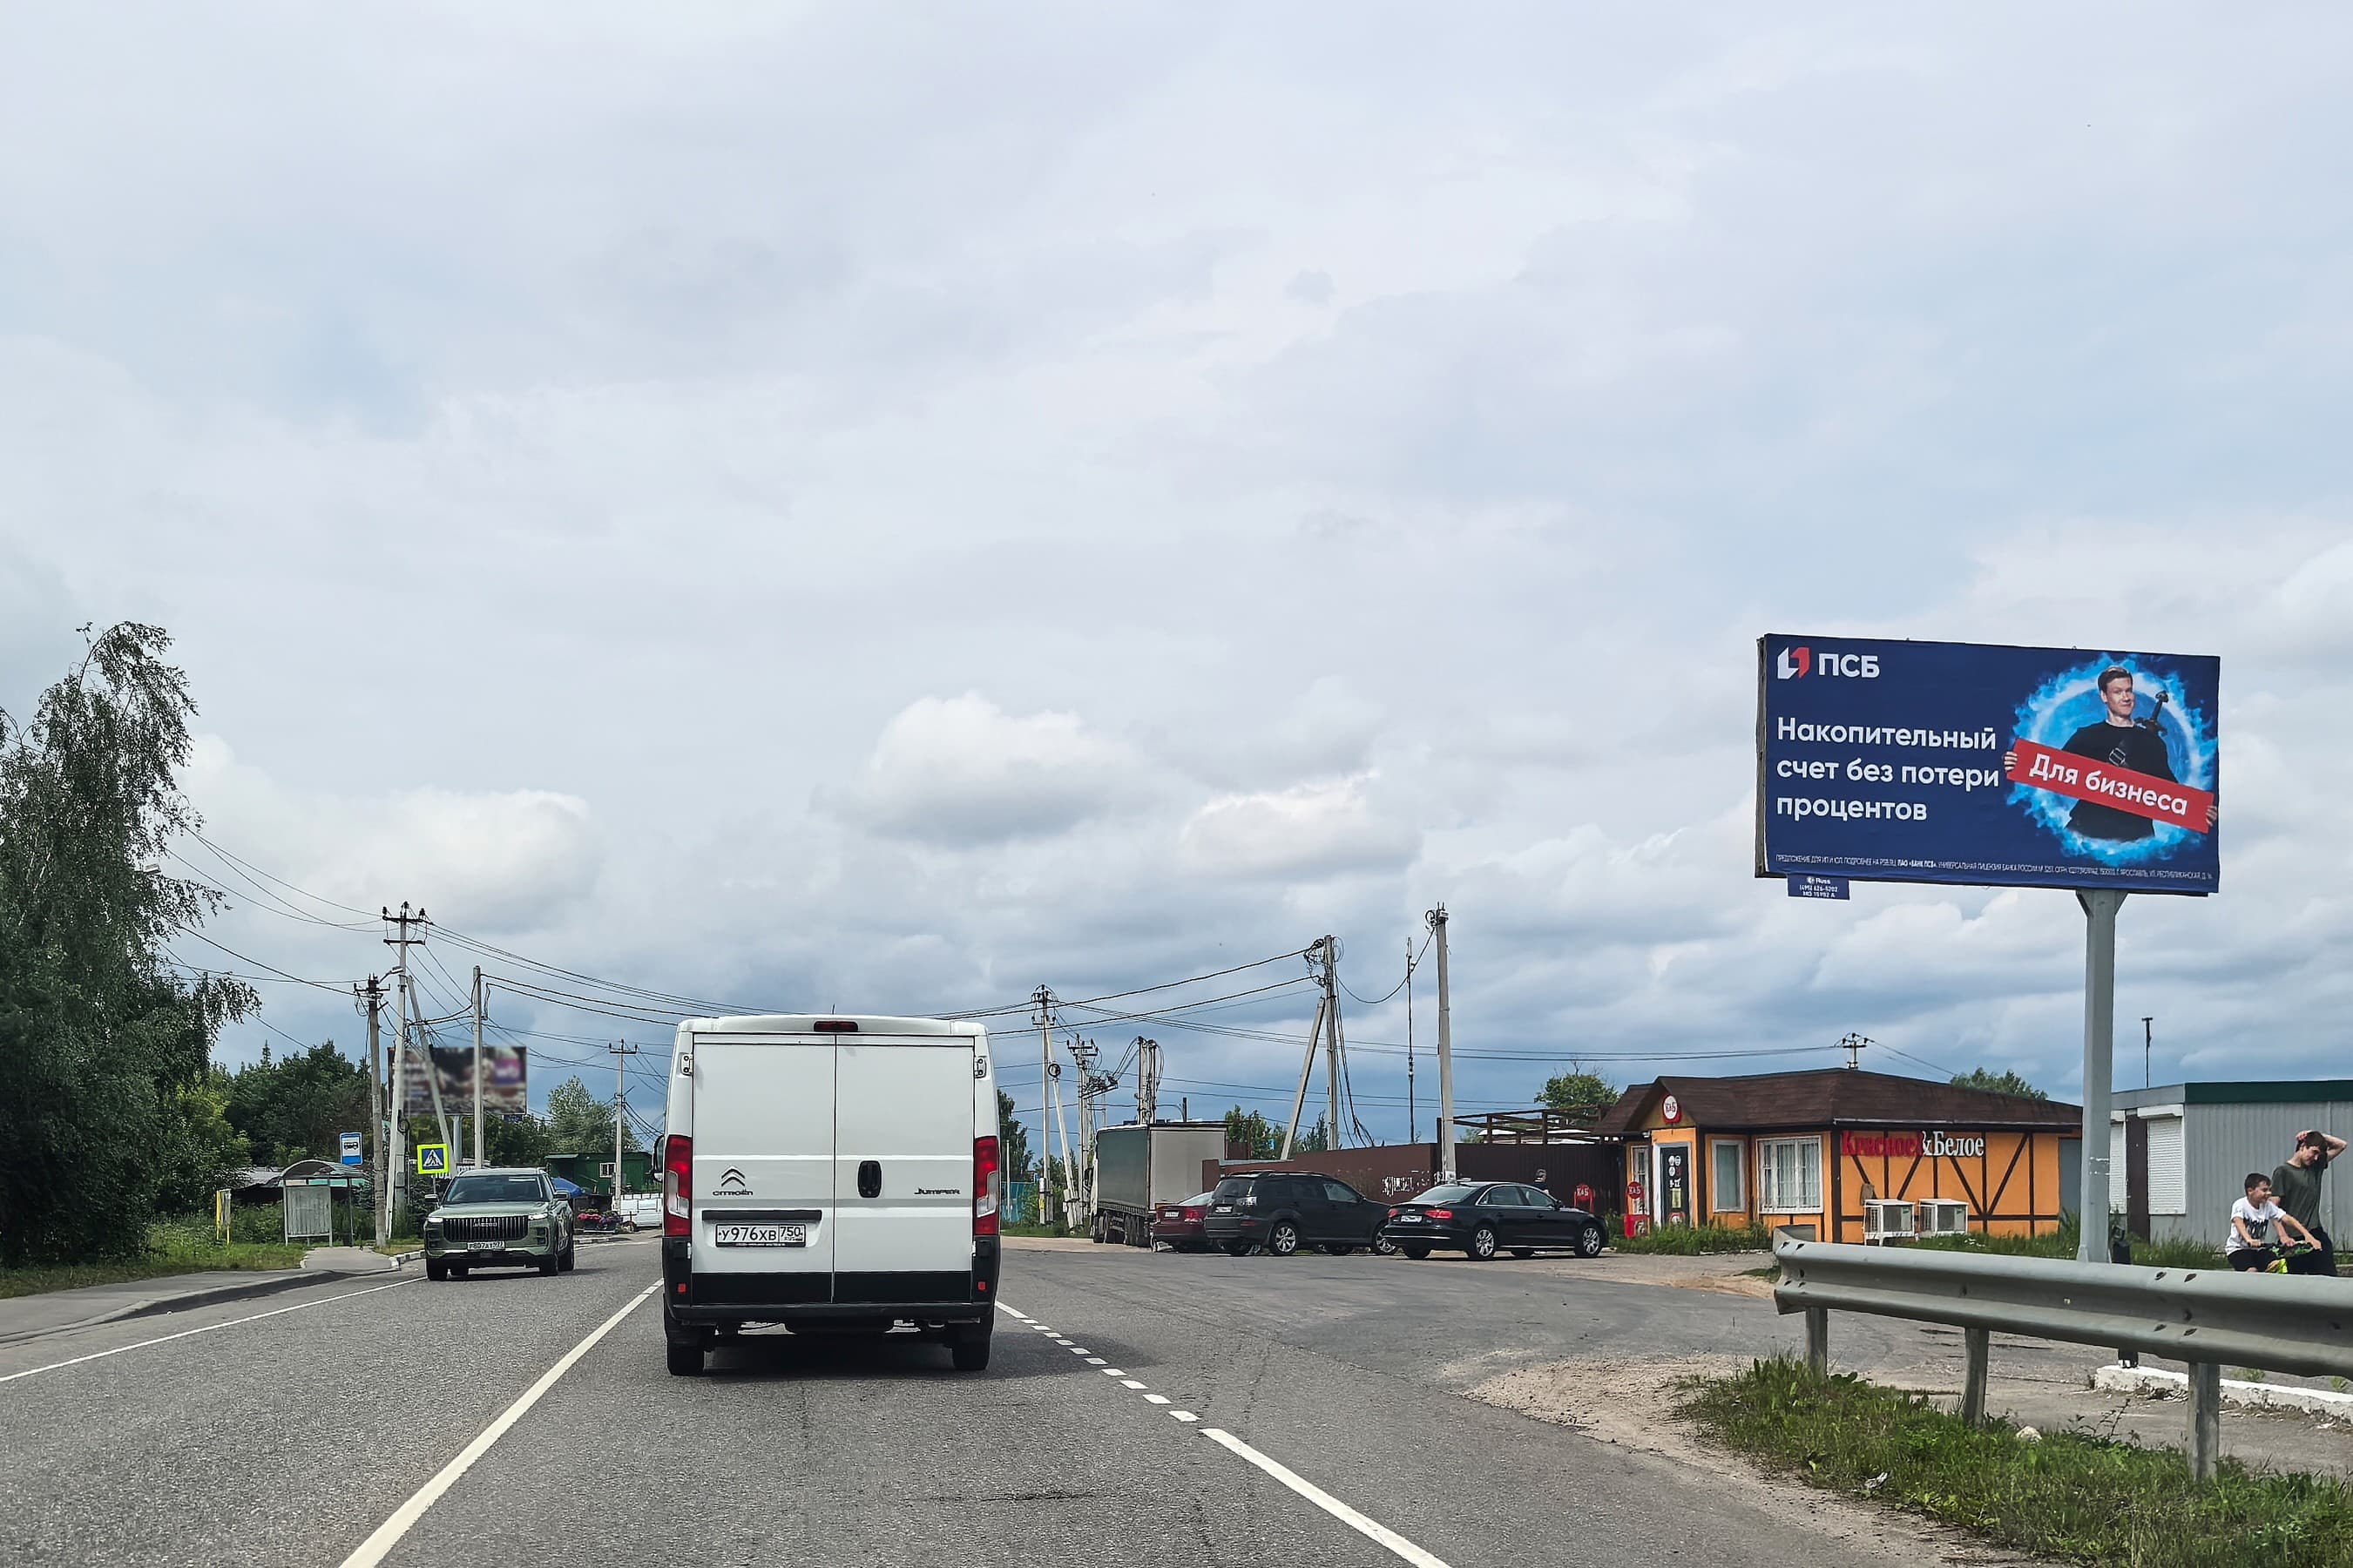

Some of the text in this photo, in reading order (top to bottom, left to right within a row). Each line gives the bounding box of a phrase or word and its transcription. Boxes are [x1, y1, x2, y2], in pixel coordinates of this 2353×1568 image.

[1818, 653, 1880, 678] ПСБ
[1777, 717, 1996, 750] Накопительный
[1776, 758, 1999, 792] счет без потери
[2028, 753, 2188, 816] Для бизнеса
[1776, 797, 1928, 821] процентов
